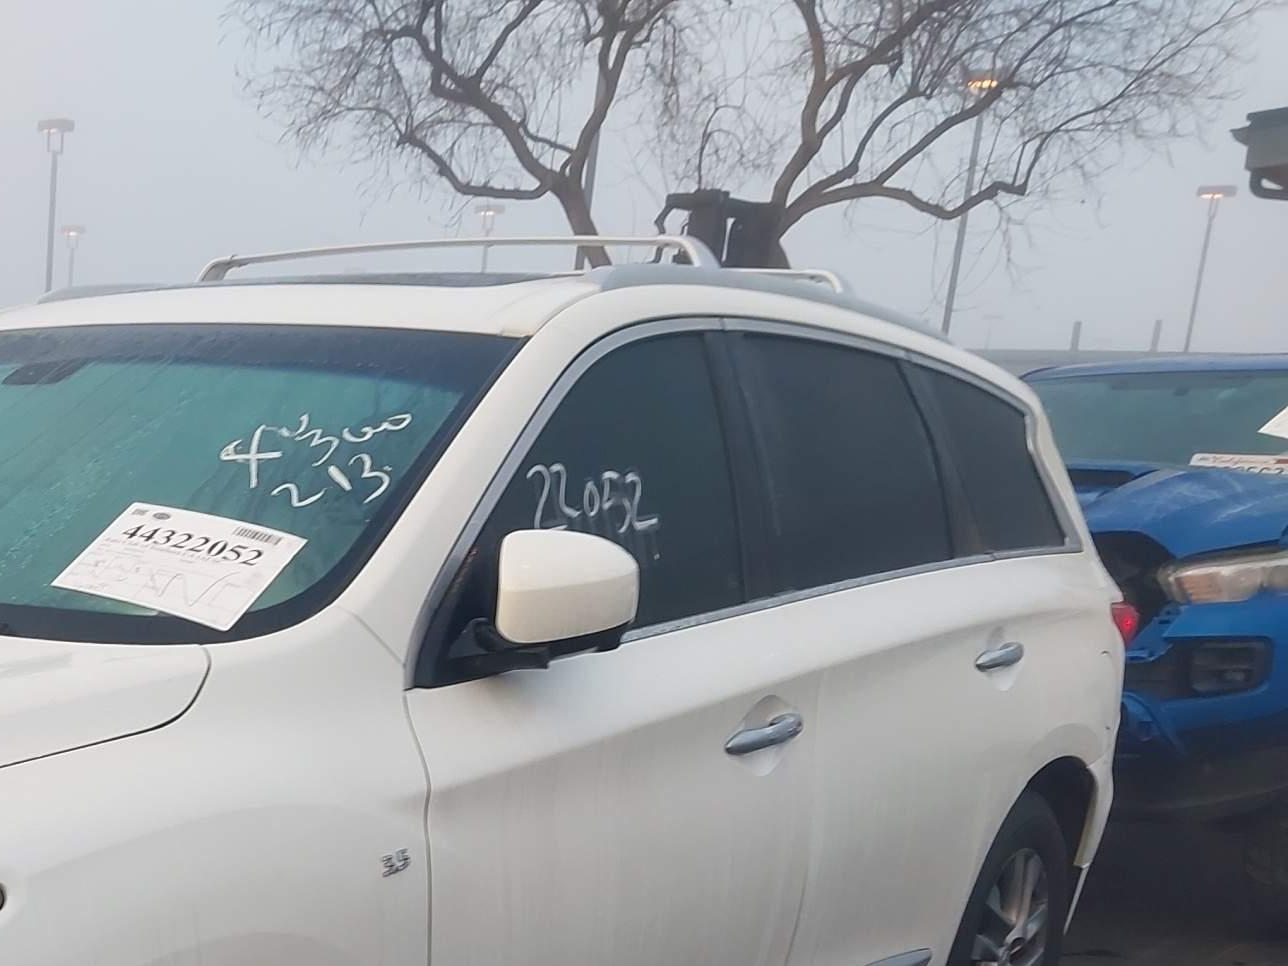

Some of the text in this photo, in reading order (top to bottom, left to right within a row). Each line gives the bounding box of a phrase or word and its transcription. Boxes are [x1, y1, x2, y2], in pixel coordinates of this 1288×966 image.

[270, 453, 393, 507] 213
[526, 462, 659, 534] 22052
[122, 523, 264, 567] 44322052
